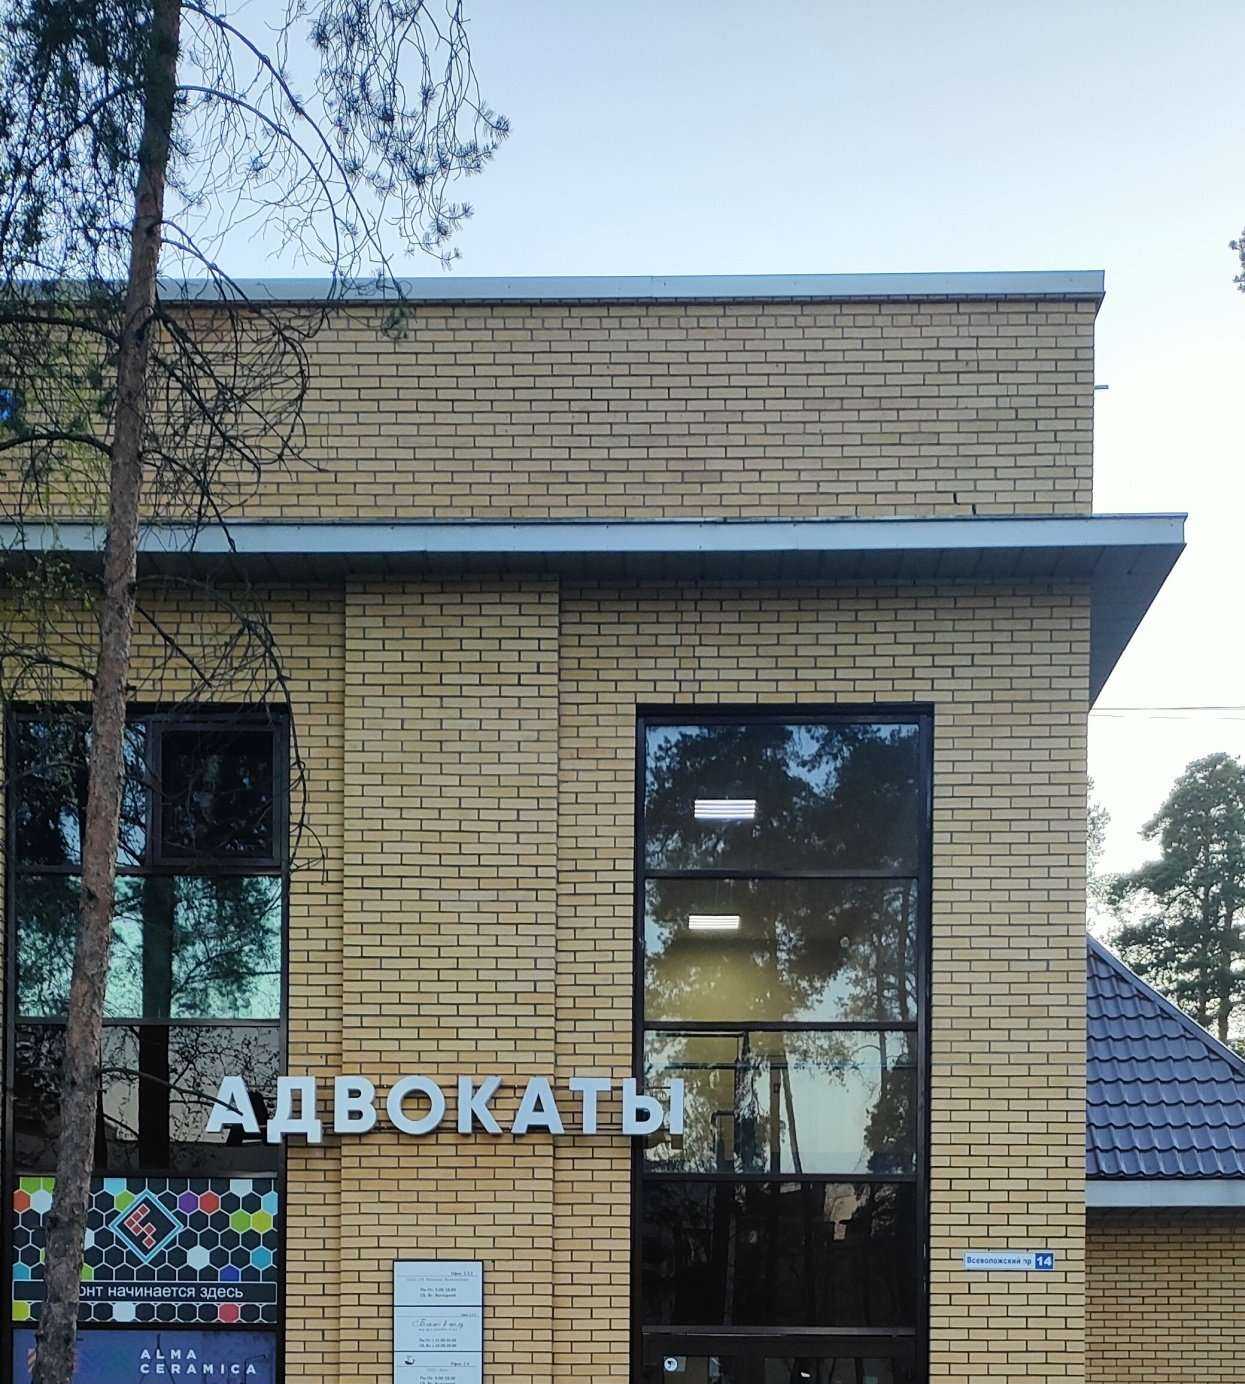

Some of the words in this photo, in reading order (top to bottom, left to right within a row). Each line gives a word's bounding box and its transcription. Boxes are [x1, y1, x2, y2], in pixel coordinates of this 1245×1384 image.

[206, 1076, 684, 1143] АДВОКАТЫ
[1036, 1256, 1052, 1267] 14
[108, 1285, 196, 1298] начинается
[200, 1285, 244, 1300] здесь
[140, 1349, 197, 1360] ALMA
[140, 1364, 257, 1375] CERAMICA
